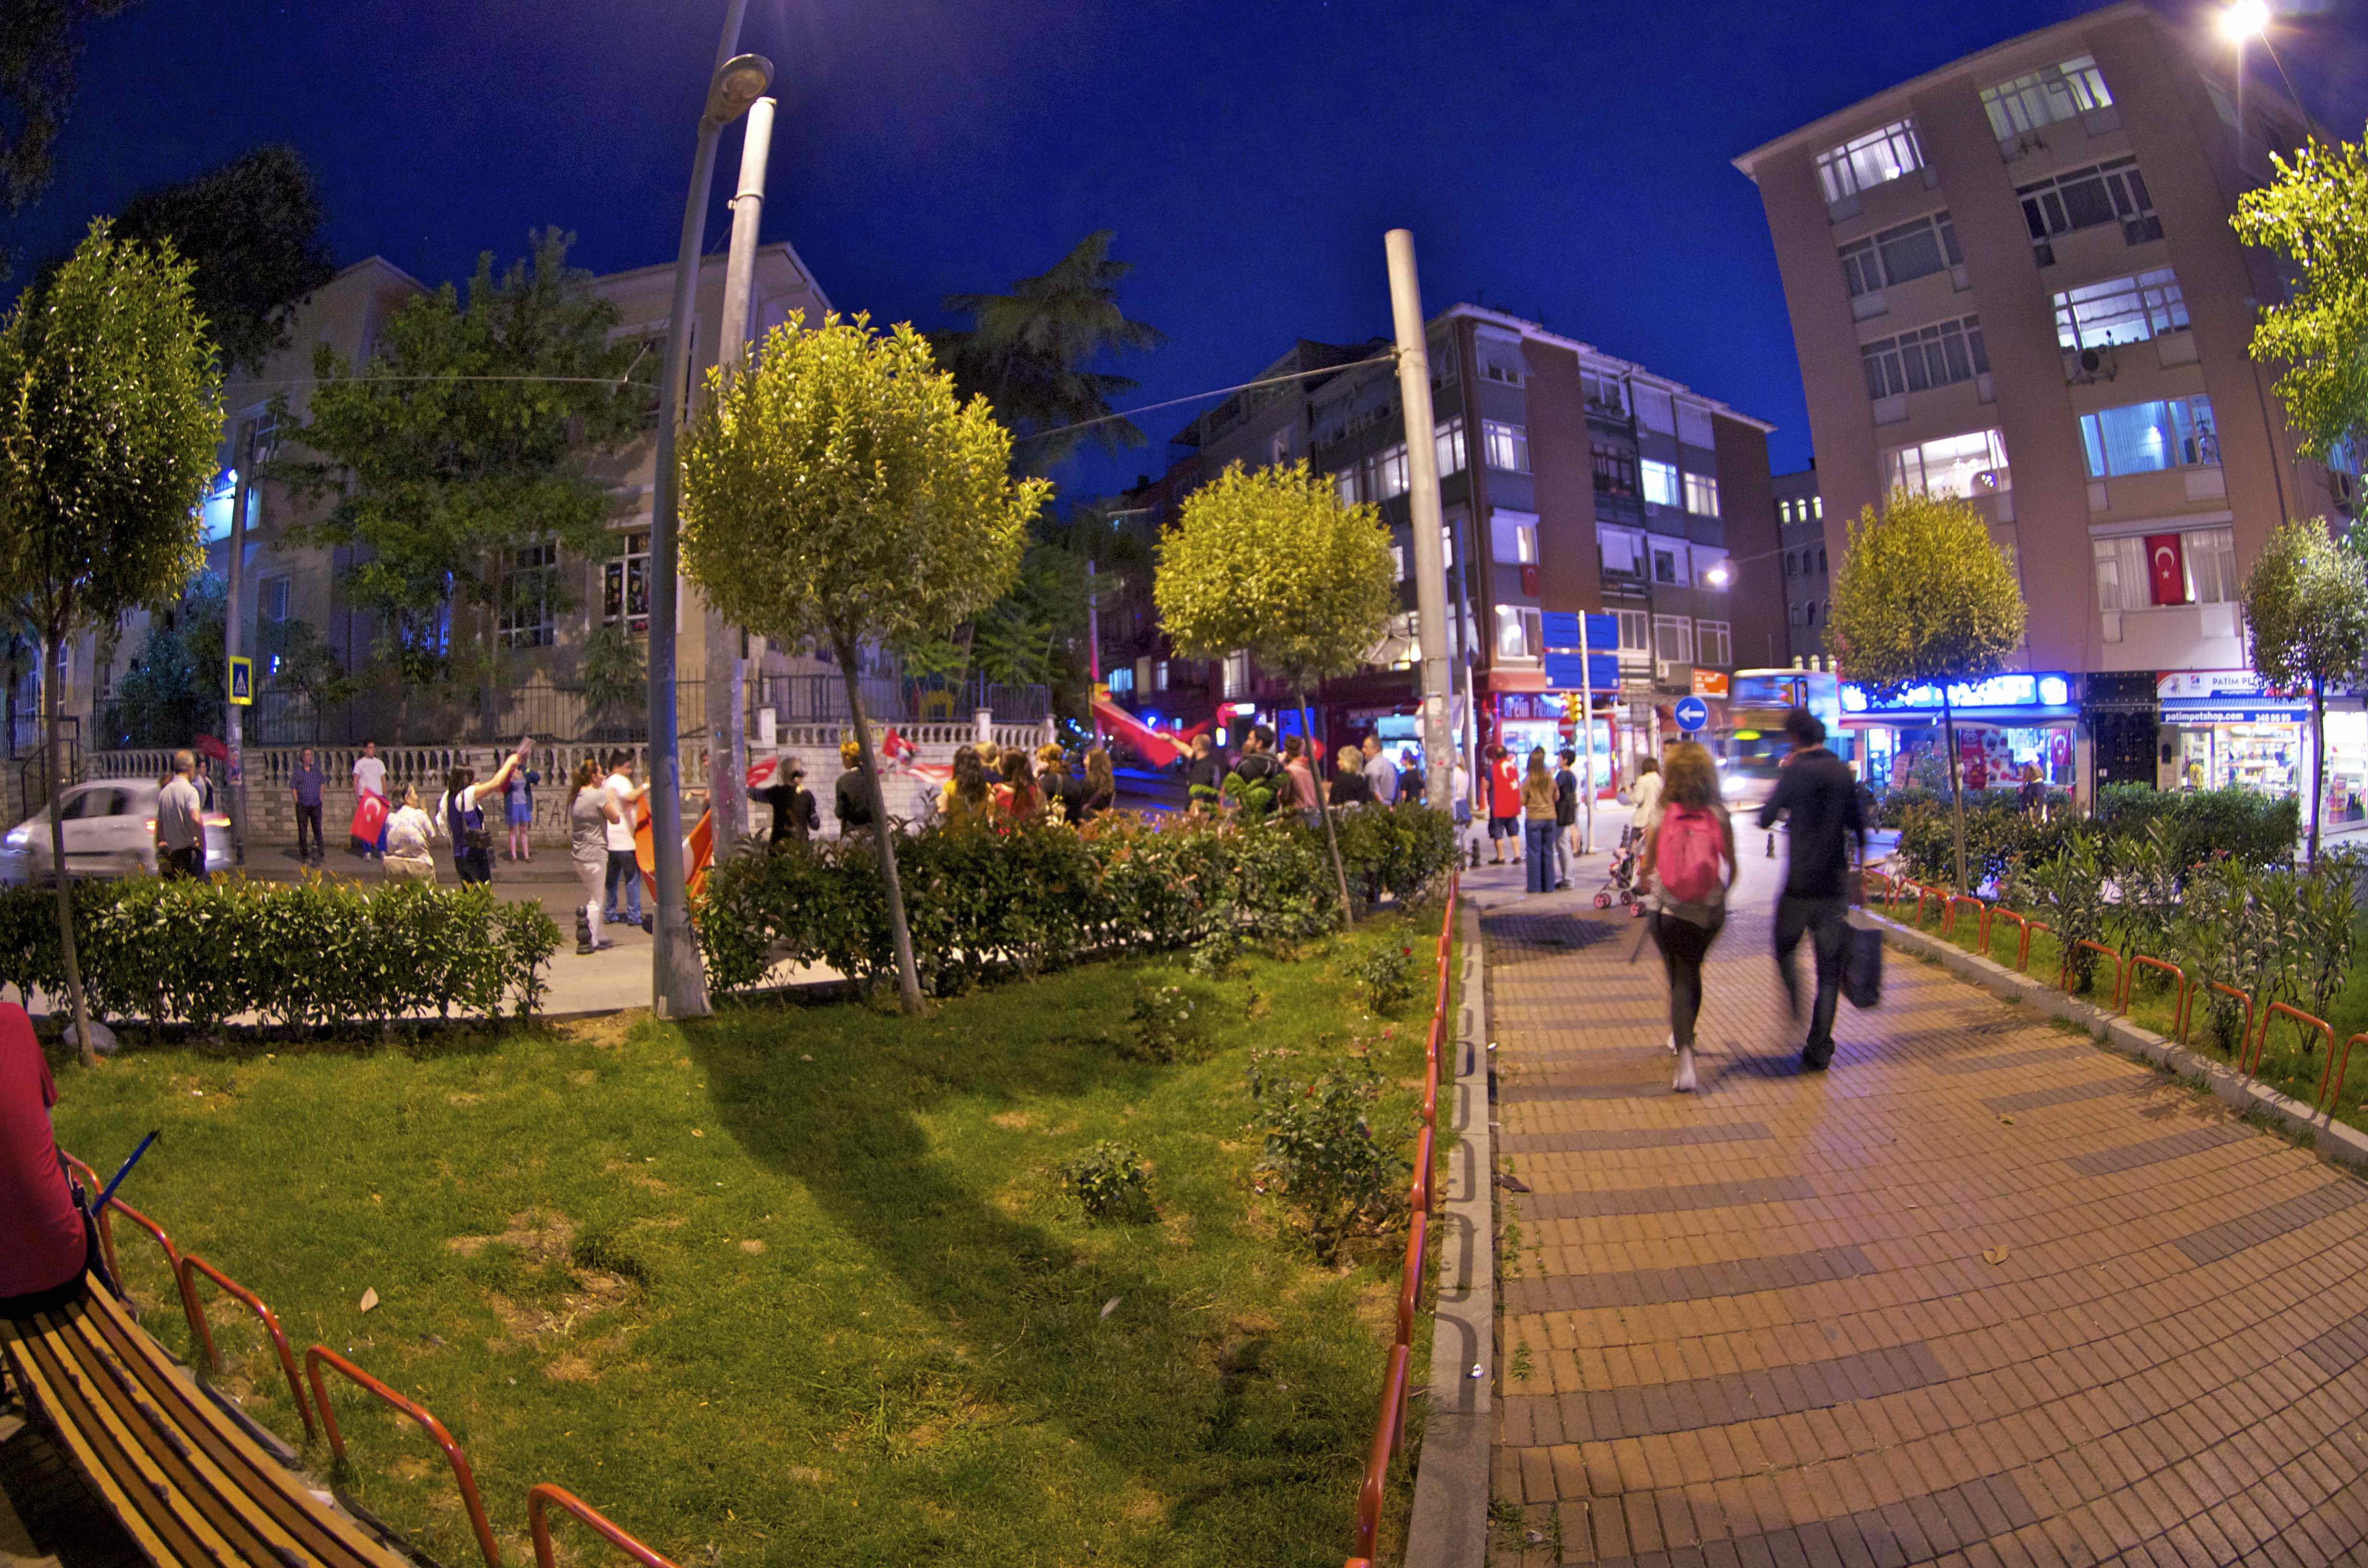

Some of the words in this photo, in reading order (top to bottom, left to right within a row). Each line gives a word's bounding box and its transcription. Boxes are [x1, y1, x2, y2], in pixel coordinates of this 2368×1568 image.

[2213, 676, 2239, 685] PATİM
[1509, 696, 1529, 718] Pelin
[2165, 711, 2244, 722] patimpetshop.com
